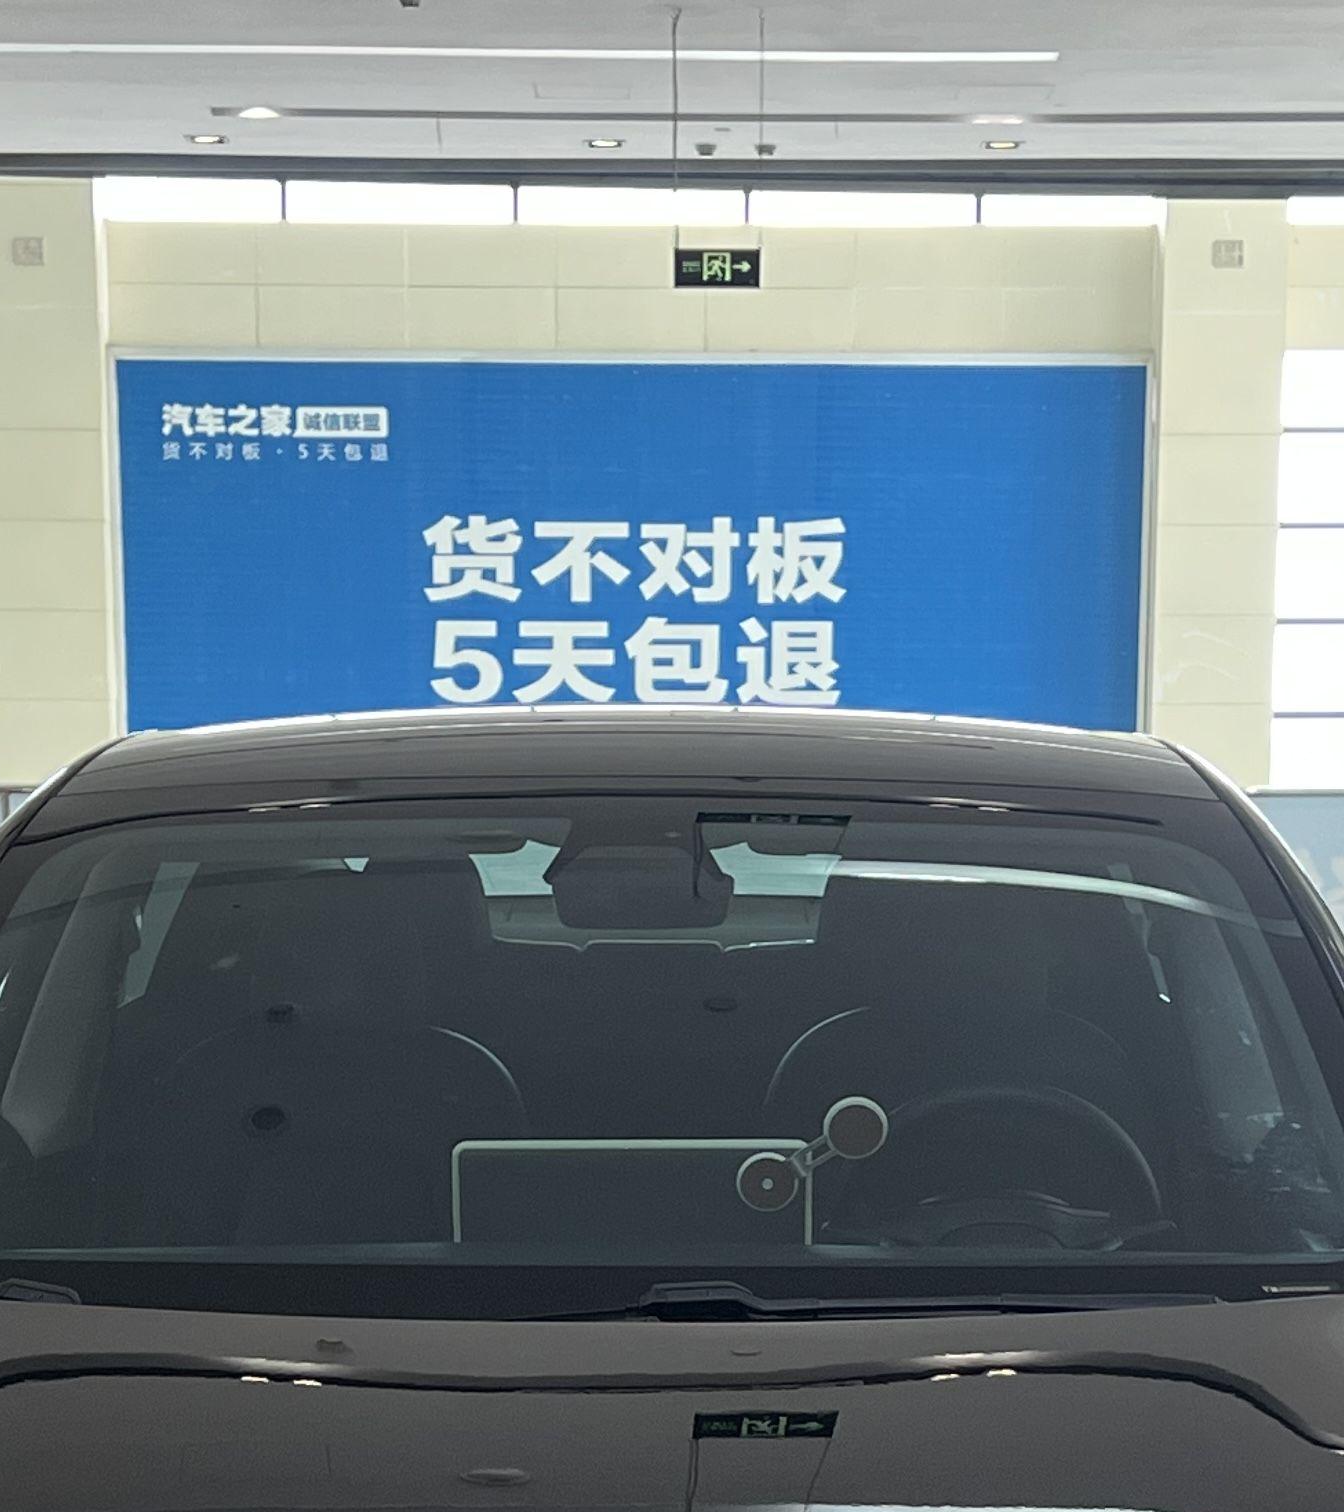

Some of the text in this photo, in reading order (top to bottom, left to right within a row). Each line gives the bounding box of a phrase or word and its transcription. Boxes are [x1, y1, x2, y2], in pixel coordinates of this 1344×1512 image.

[161, 403, 382, 437] 汽车之家 诚信联盟
[422, 515, 847, 604] 货不对板
[430, 616, 840, 705] 5天包退
